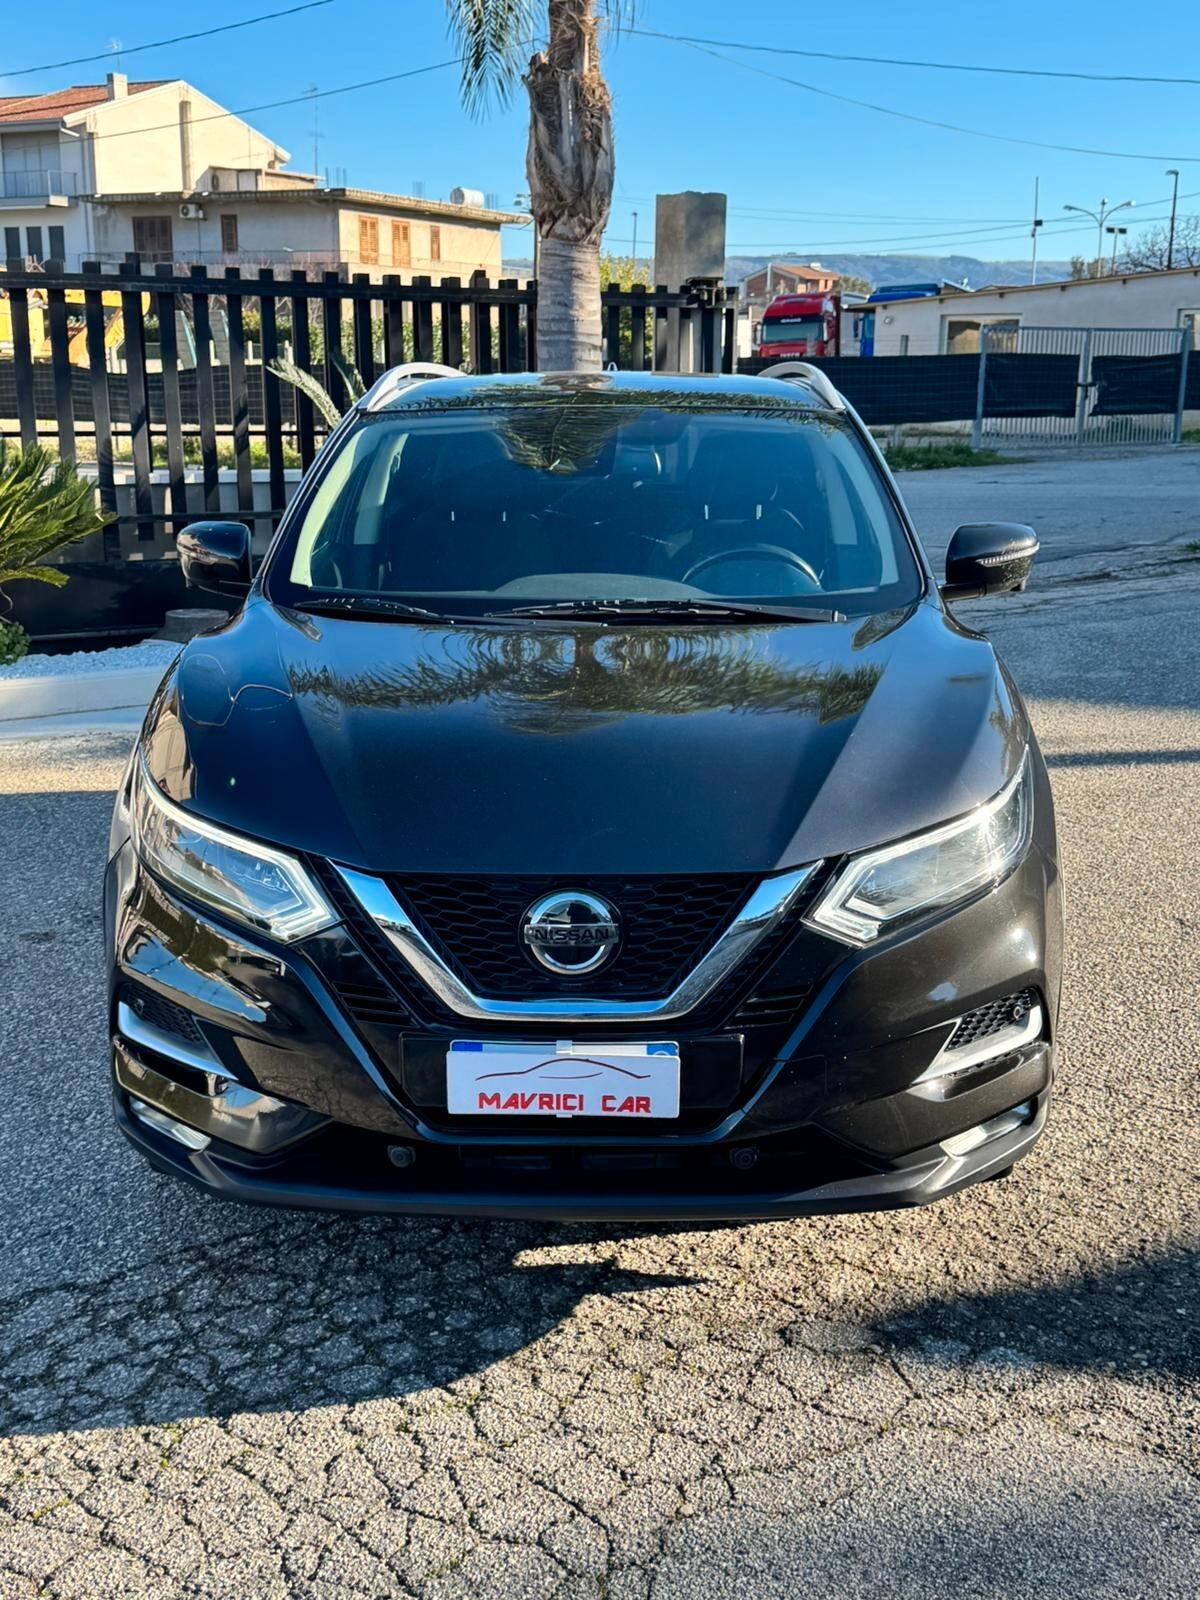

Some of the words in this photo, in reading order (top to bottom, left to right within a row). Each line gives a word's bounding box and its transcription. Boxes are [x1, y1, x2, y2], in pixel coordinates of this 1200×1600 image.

[534, 928, 609, 941] NISSAN
[478, 1092, 584, 1111] MAVRICI
[601, 1095, 652, 1113] CAR
